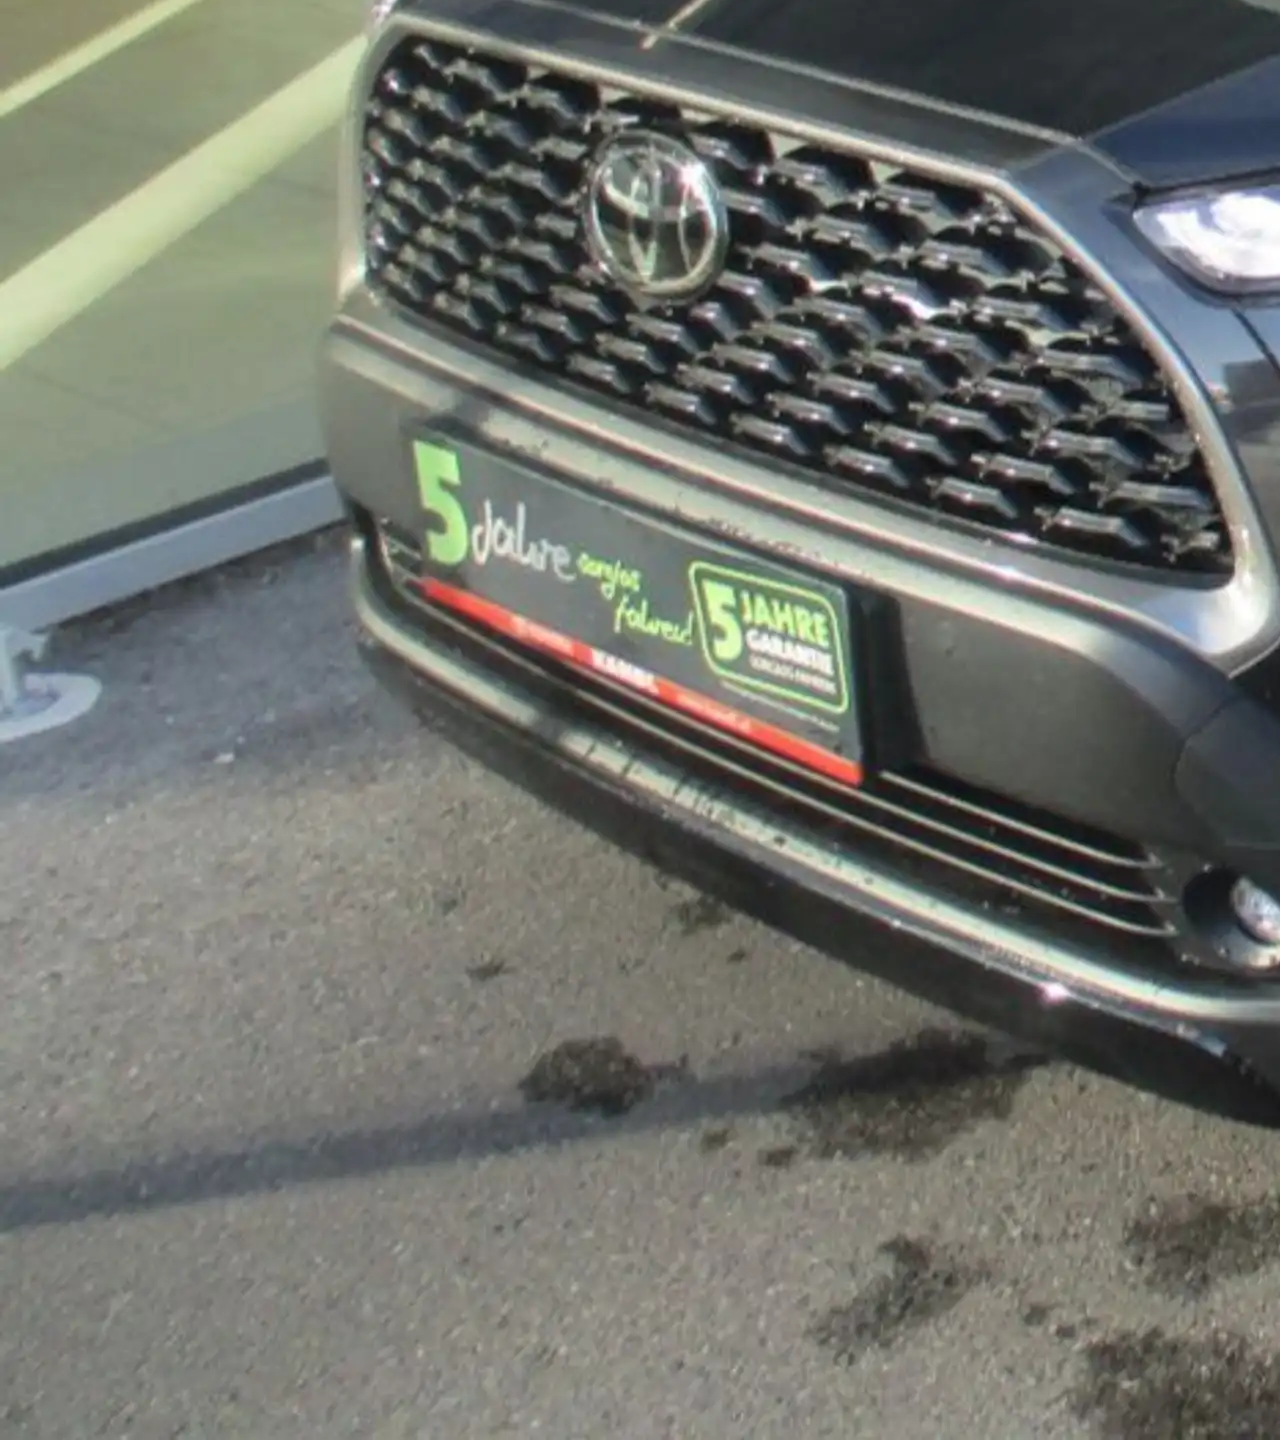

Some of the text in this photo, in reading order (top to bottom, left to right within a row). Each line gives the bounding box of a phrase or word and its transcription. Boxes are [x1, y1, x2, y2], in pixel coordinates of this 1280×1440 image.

[413, 440, 468, 566] 5
[701, 577, 830, 661] 5 JAHRE
